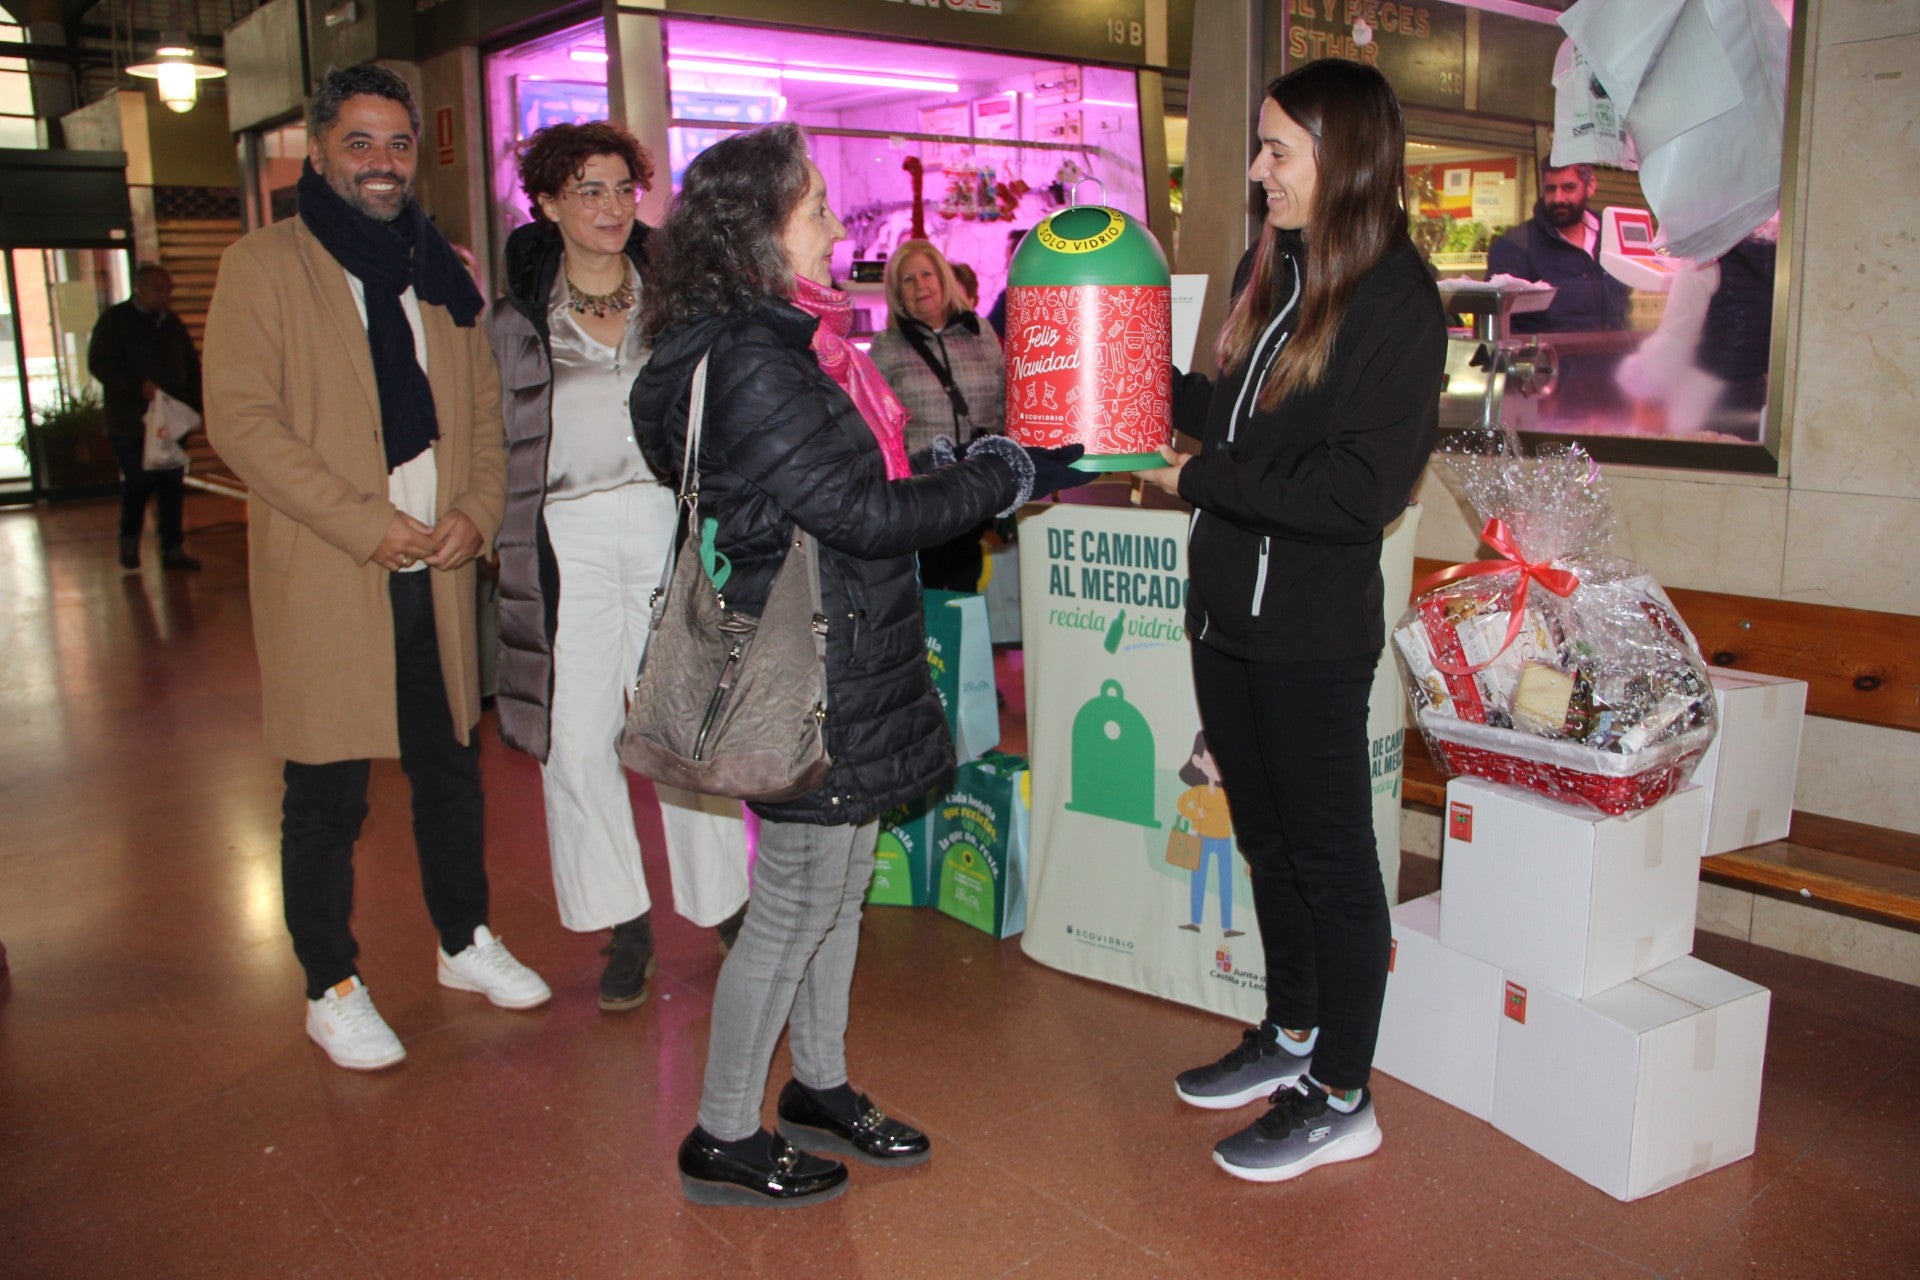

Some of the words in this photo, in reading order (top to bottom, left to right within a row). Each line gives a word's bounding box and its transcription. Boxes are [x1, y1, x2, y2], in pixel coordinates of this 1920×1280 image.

[1345, 0, 1430, 38] PECES
[1106, 18, 1124, 43] 19
[1130, 22, 1142, 46] B
[1040, 228, 1066, 250] SOLO
[1073, 227, 1119, 250] VIDRIO
[1023, 324, 1060, 352] Feliz
[1012, 348, 1081, 380] Navidad
[1025, 413, 1064, 421] ECOVIDRIO
[1047, 527, 1075, 561] DE
[1081, 530, 1177, 571] CAMINO
[1050, 564, 1076, 597] AL
[1049, 607, 1106, 632] recicla
[1127, 614, 1185, 642] vidrio
[1372, 737, 1384, 758] DE
[1372, 758, 1382, 778] AL
[1076, 929, 1134, 949] ECOVIDRIO
[1210, 969, 1239, 985] Castilla
[1249, 981, 1266, 991] Leó
[1233, 969, 1258, 980] Junta
